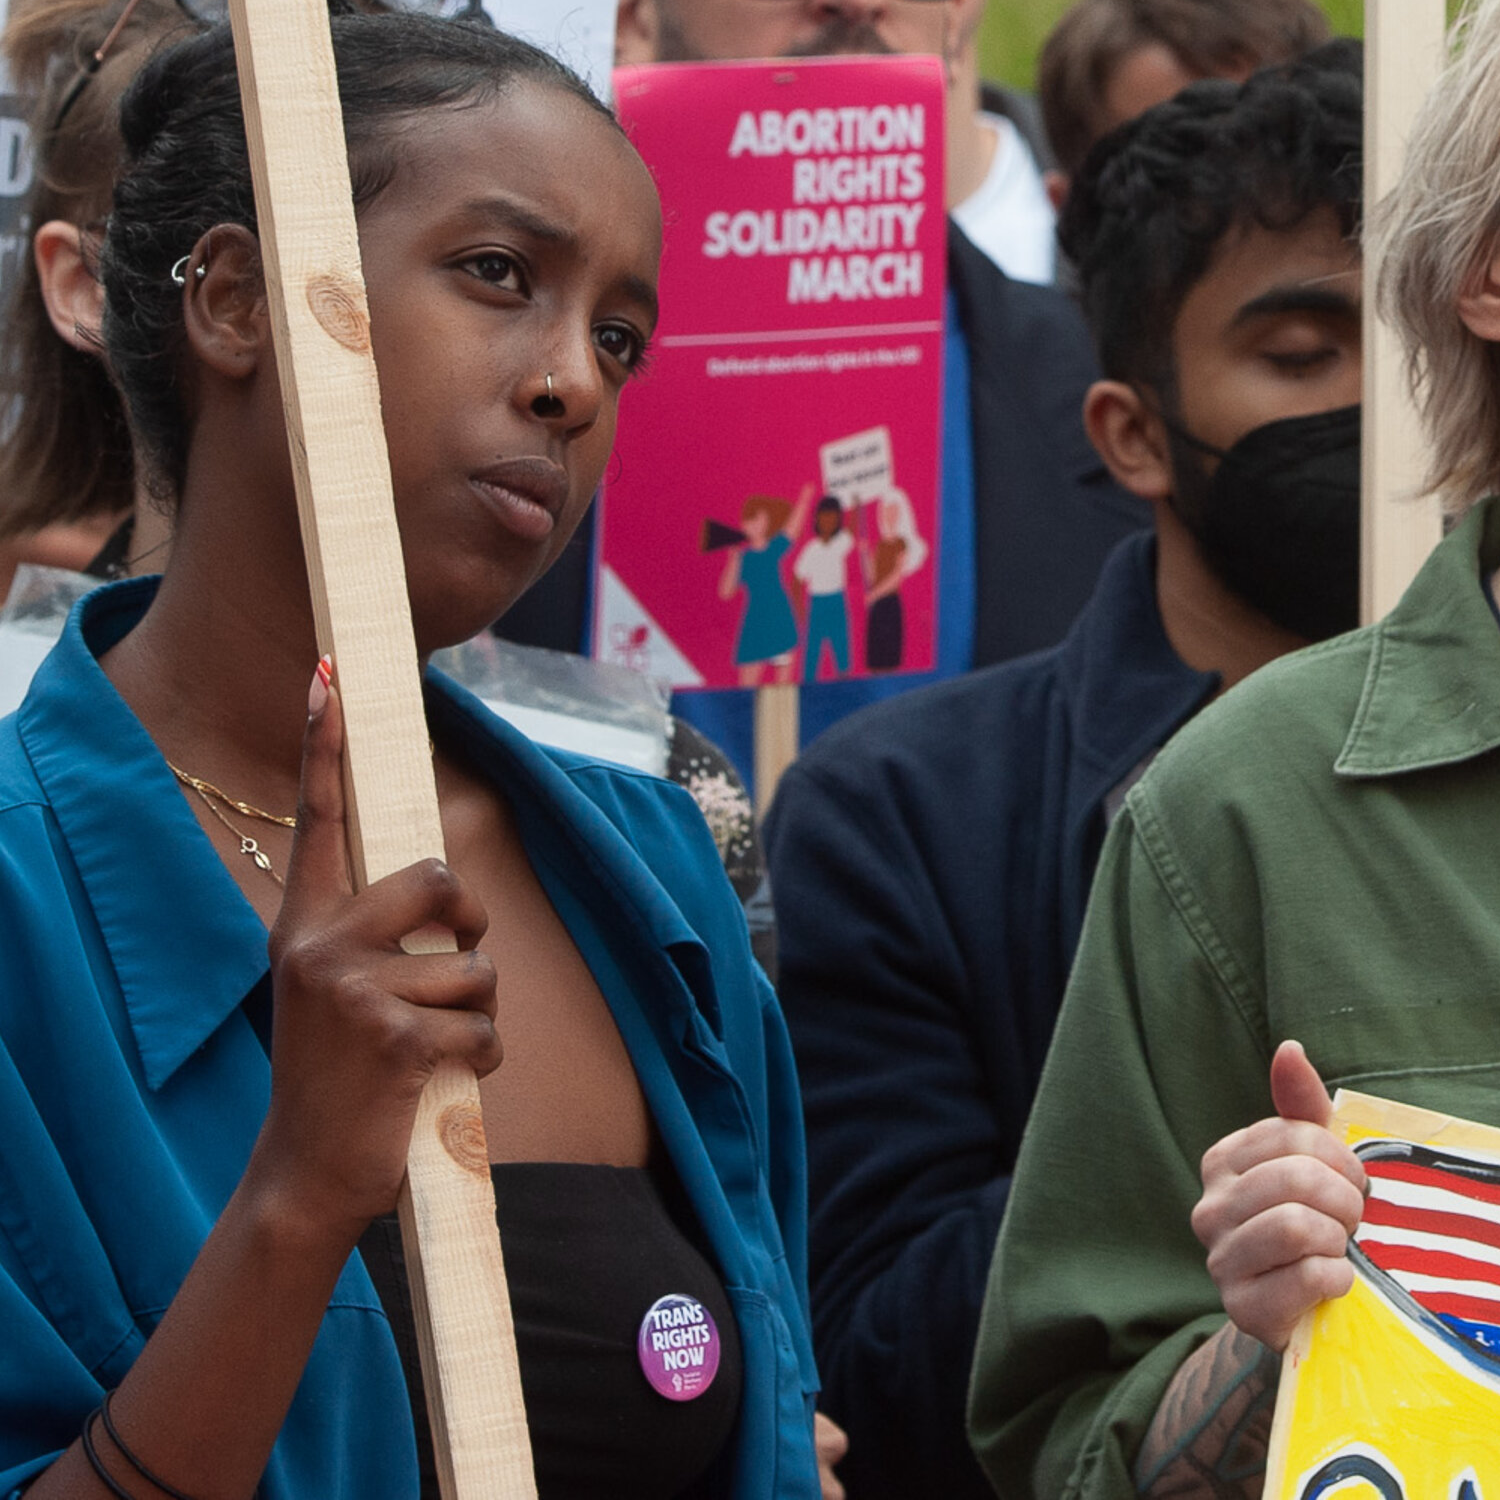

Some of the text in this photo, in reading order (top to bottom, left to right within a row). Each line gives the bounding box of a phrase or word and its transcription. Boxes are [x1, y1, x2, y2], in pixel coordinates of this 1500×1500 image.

[728, 104, 924, 158] ABORTION
[792, 154, 924, 204] RIGHTS
[702, 203, 924, 258] SOLIDARITY
[787, 252, 923, 305] MARCH
[651, 1304, 704, 1330] TRANS
[652, 1324, 711, 1352] RIGHTS
[663, 1346, 705, 1371] NOW
